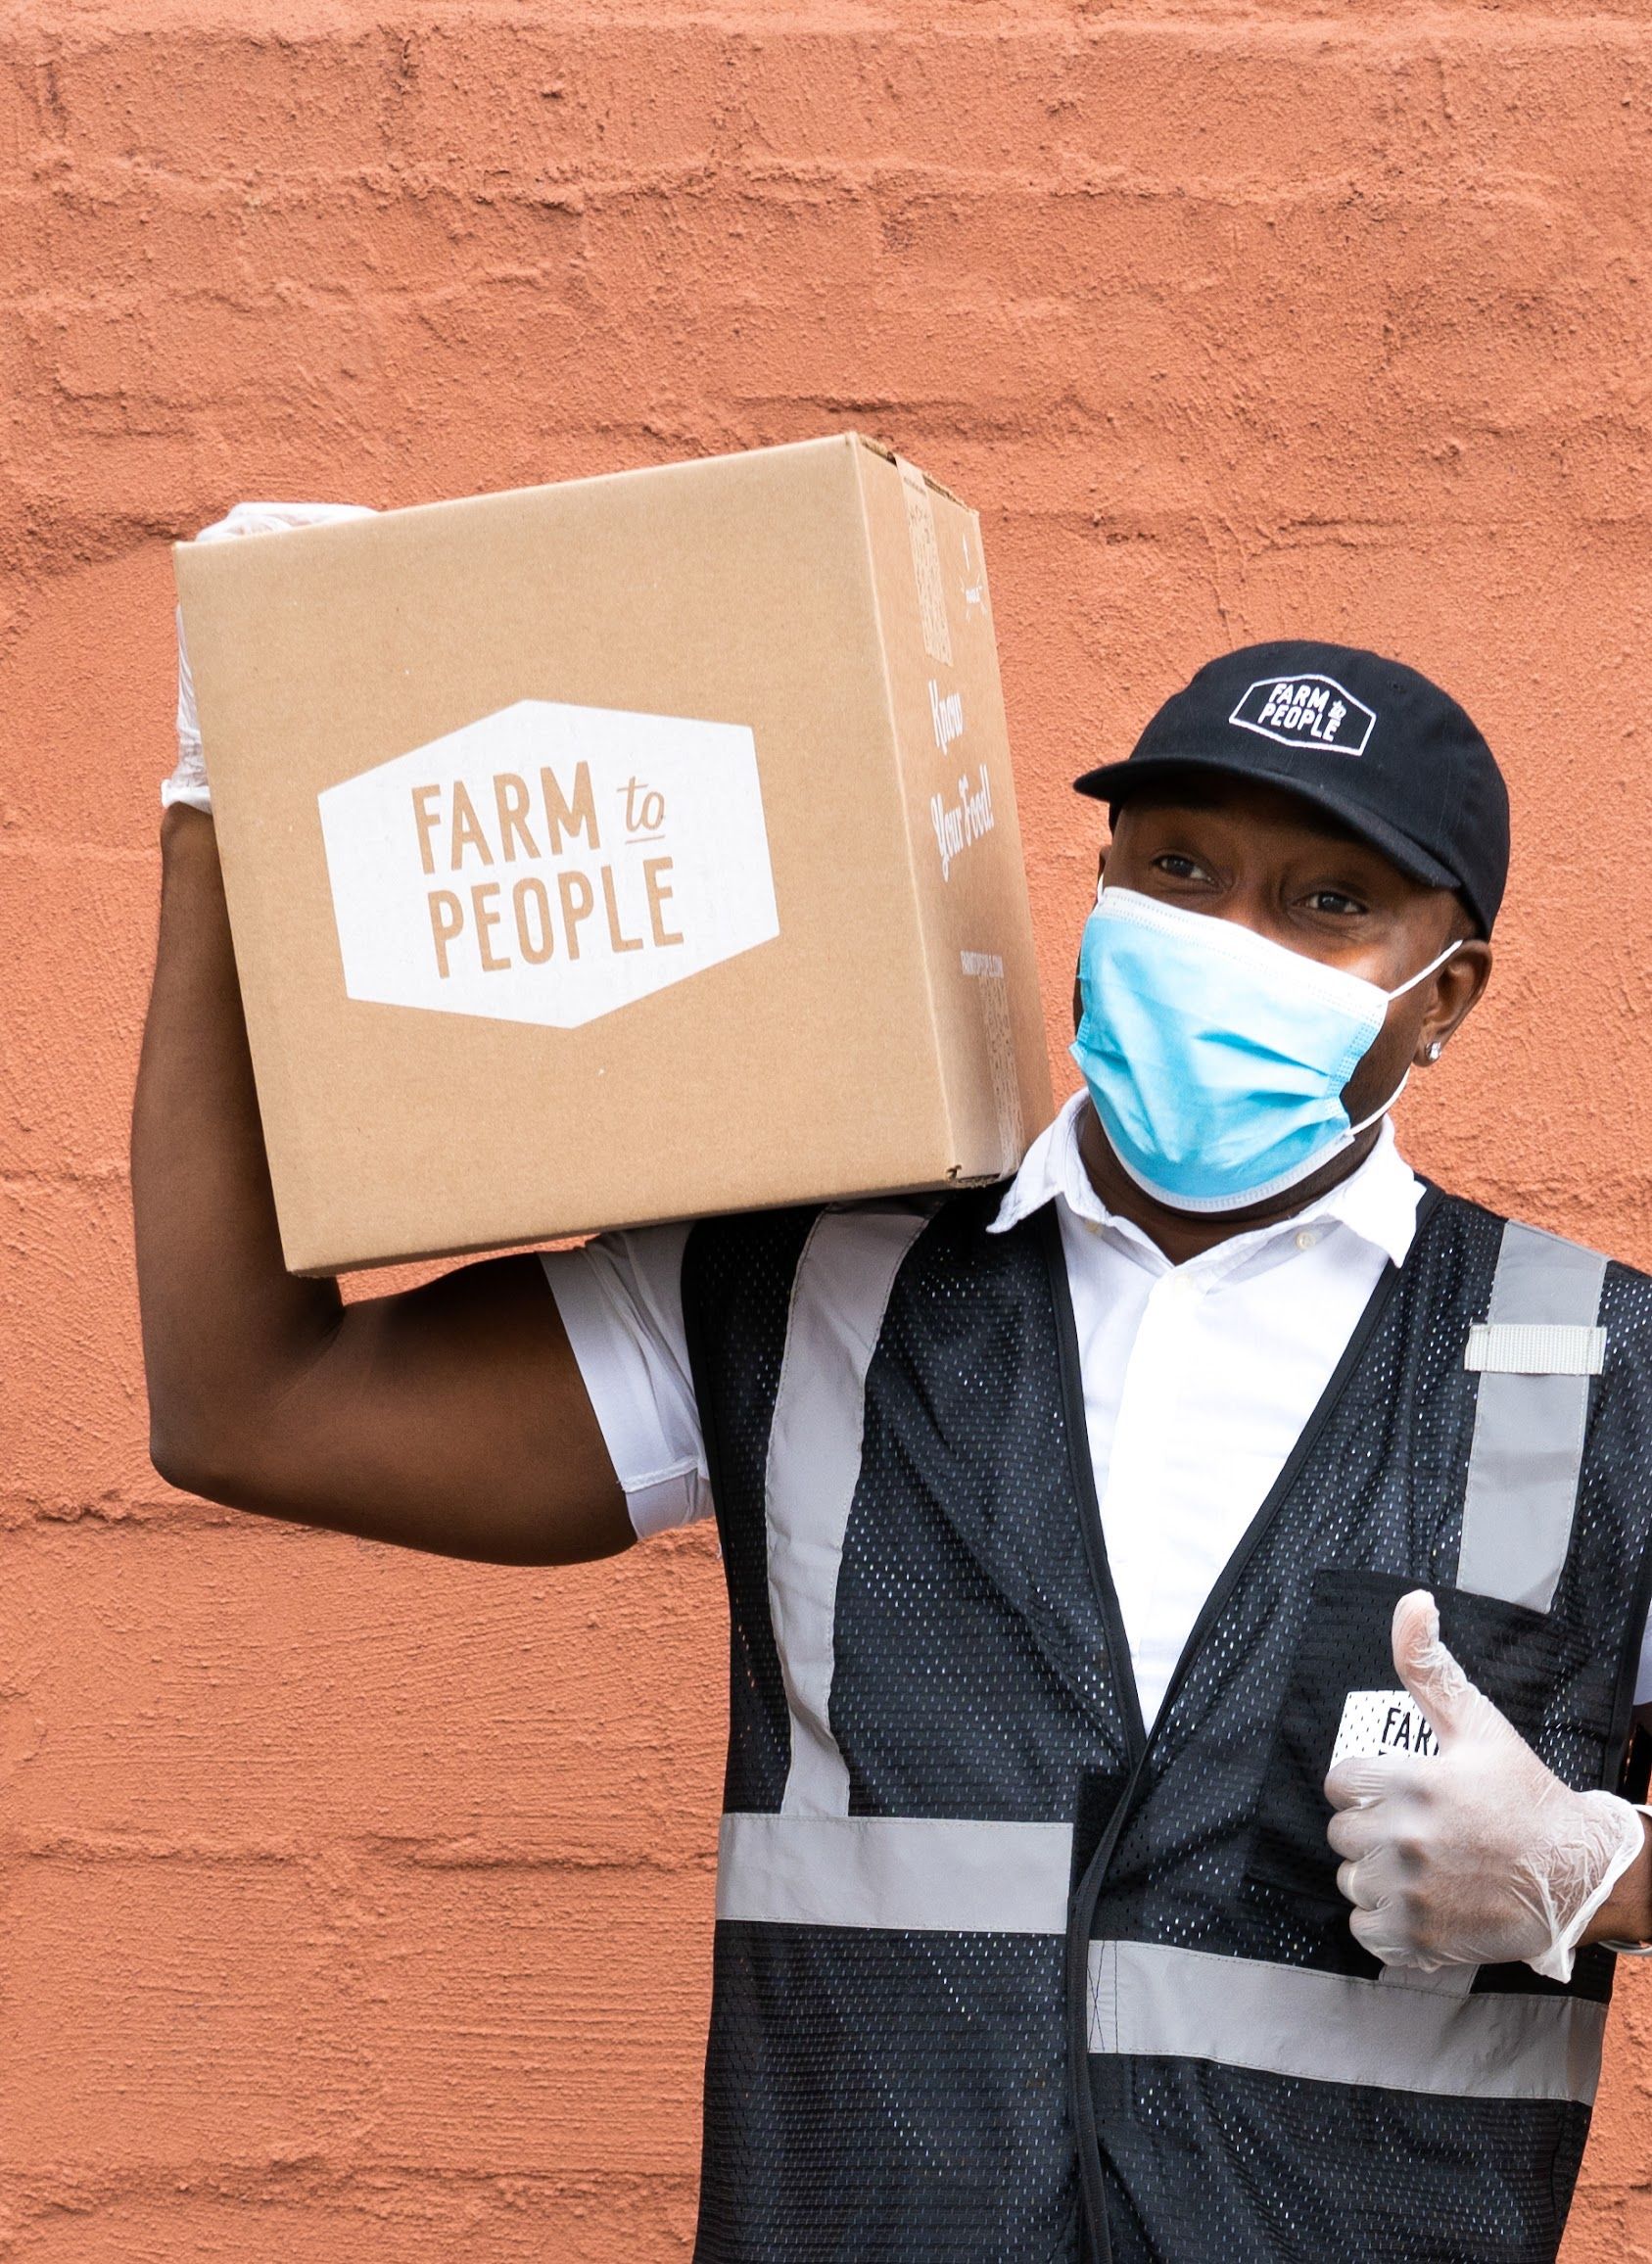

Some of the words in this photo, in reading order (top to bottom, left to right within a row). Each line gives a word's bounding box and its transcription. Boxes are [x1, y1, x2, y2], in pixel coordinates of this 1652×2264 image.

[928, 679, 964, 755] Know
[1256, 703, 1341, 742] PEOPLE
[1268, 683, 1330, 713] FARM
[410, 760, 601, 874] FARM
[616, 776, 666, 834] to
[930, 792, 965, 882] Your
[427, 856, 684, 979] PEOPLE
[1381, 1707, 1440, 1756] FAR
